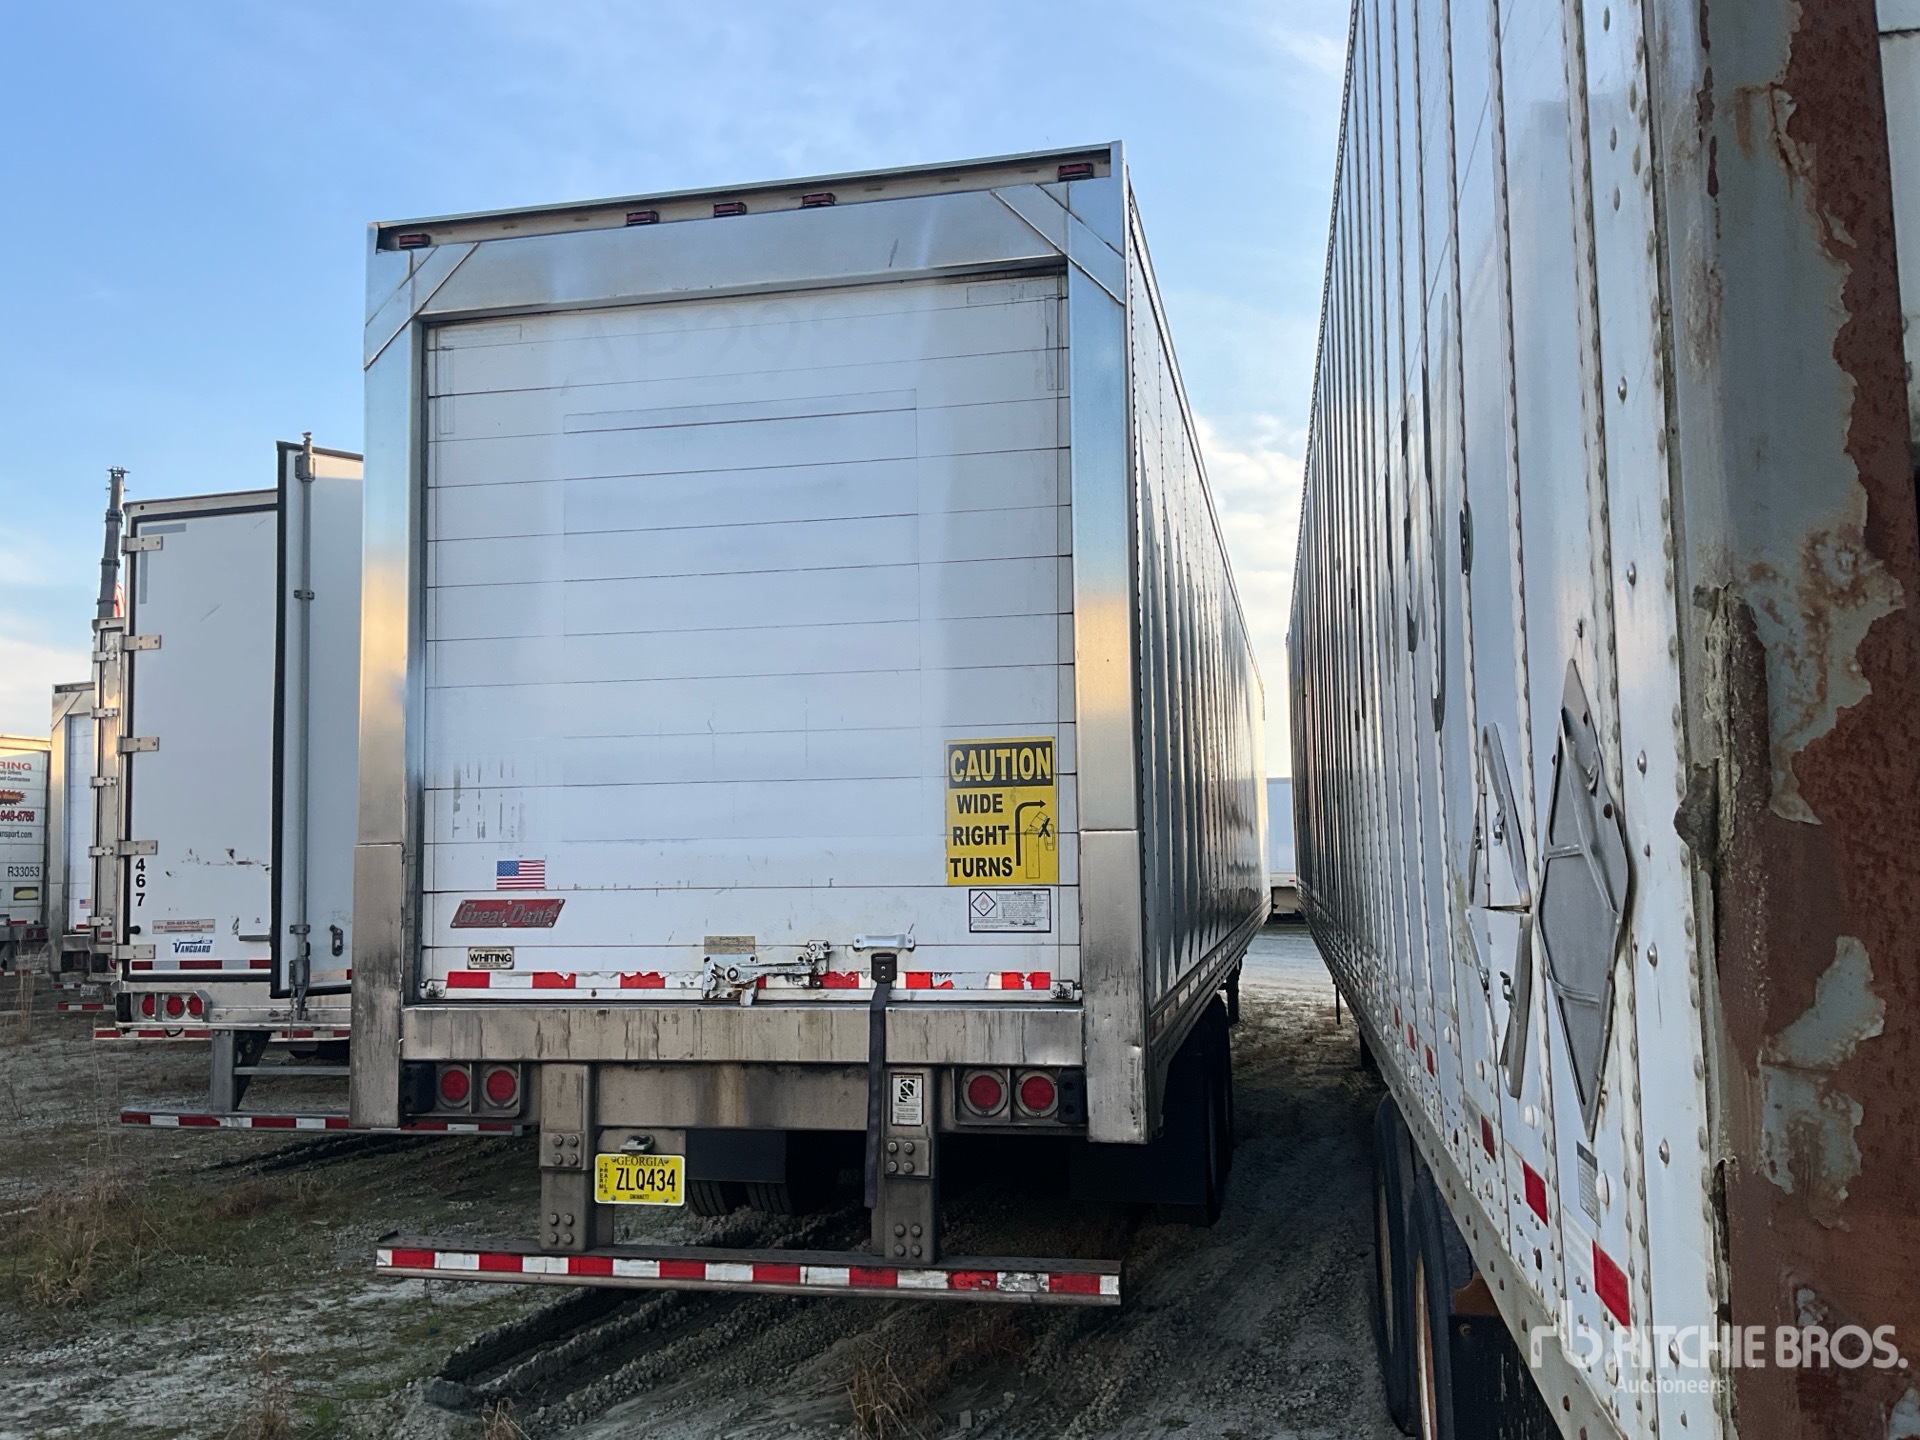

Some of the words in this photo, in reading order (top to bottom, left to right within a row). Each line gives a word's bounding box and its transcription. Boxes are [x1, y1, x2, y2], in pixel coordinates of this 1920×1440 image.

[950, 747, 1051, 783] CAUTION
[956, 793, 1004, 814] WIDE
[952, 825, 1009, 846] RIGHT
[8, 866, 40, 877] R33053
[950, 857, 1013, 878] TURNS
[458, 903, 507, 923] Great
[508, 903, 553, 923] Dane
[172, 941, 212, 953] VANGUARD
[469, 953, 512, 962] WHITING
[616, 1156, 665, 1166] GEORGIA
[616, 1168, 676, 1192] ZLQ434
